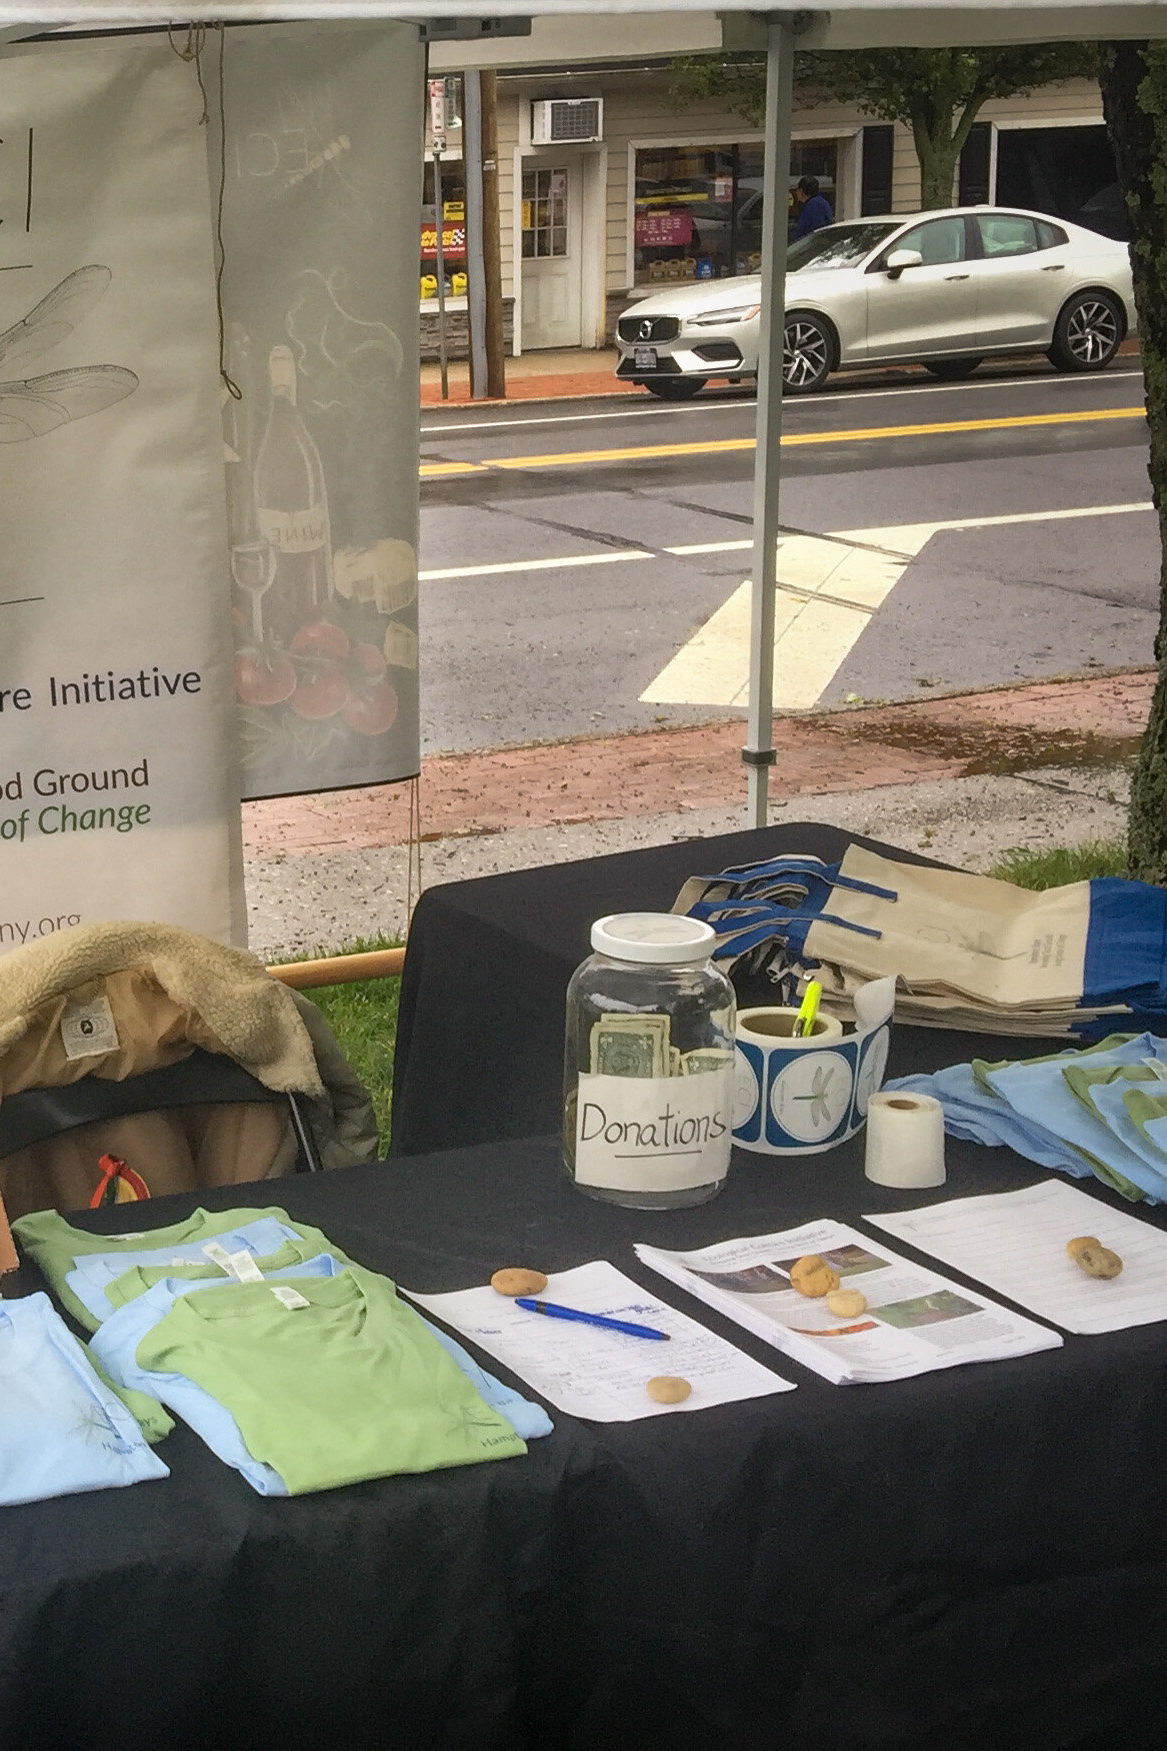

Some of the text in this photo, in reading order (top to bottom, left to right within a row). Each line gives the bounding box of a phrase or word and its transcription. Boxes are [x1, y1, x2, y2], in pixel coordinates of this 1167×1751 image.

[49, 666, 202, 707] Initiative
[33, 758, 150, 797] Ground
[0, 808, 31, 842] of
[37, 802, 152, 835] Change
[581, 1103, 727, 1148] Donations
